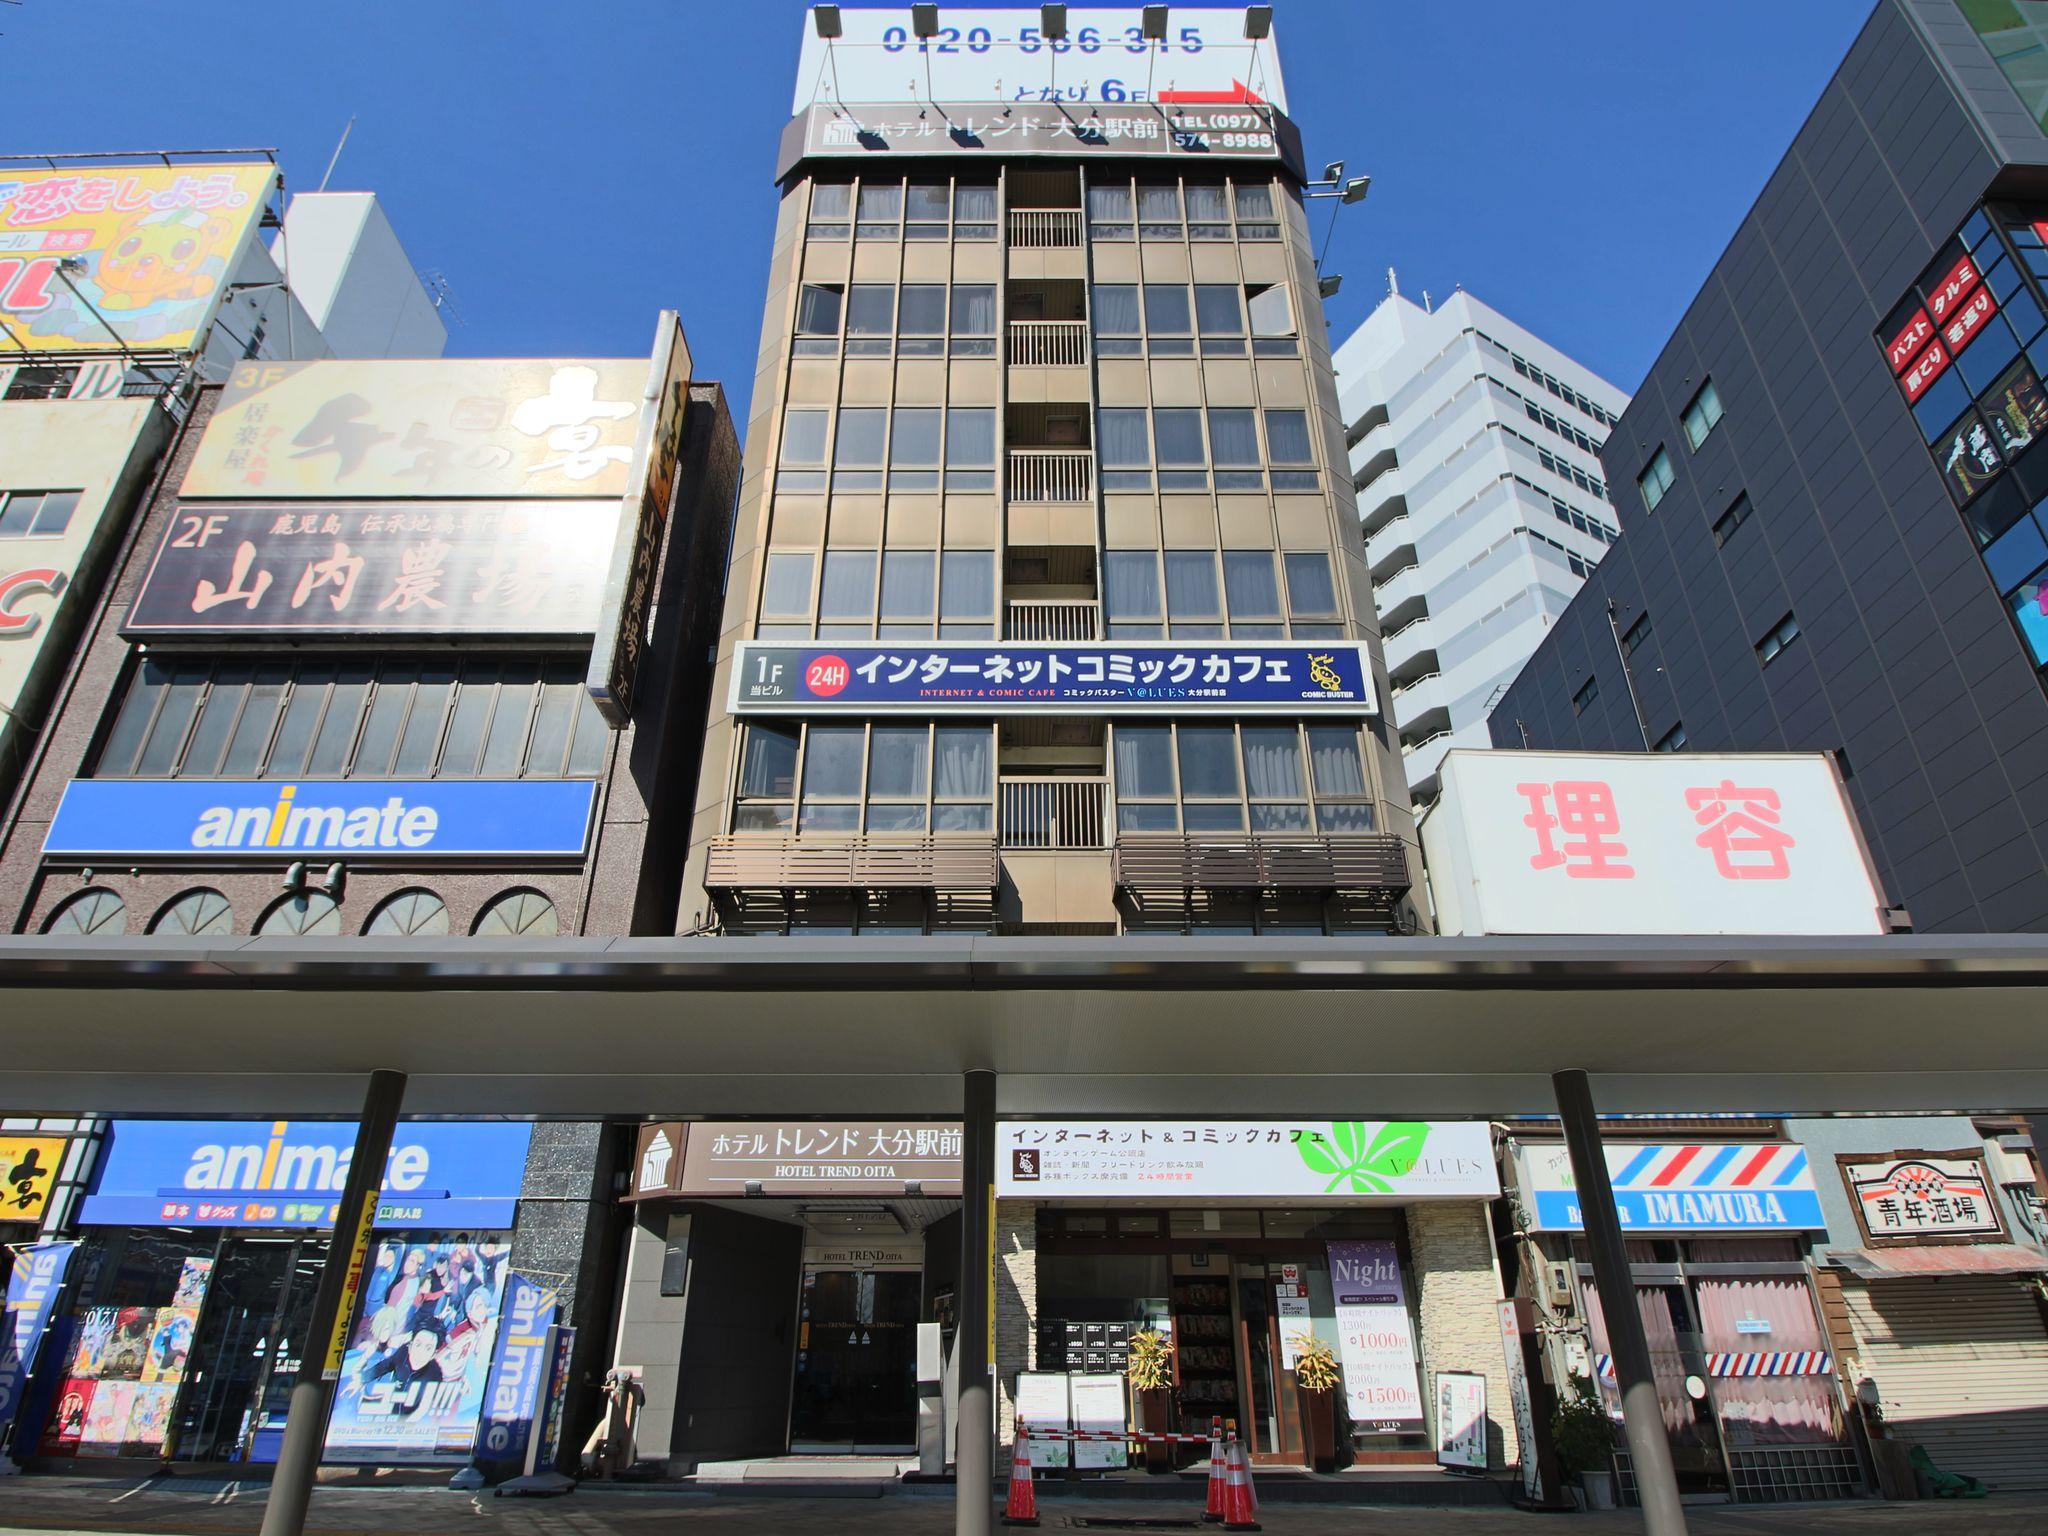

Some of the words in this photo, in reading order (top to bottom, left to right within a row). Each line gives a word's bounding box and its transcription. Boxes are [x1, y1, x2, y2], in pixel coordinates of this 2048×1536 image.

[1174, 133, 1272, 148] 574-8988
[1933, 265, 1973, 315] タルミ
[1893, 320, 1928, 364] バスト
[235, 367, 286, 389] 3F
[172, 515, 229, 548] 2F
[269, 513, 342, 535] 鹿児島
[756, 656, 783, 683] 1F
[810, 666, 845, 686] 24H
[856, 654, 1292, 684] インターネットコミックカフェ
[750, 685, 783, 697] 当ビル
[920, 688, 973, 697] INTERNET
[977, 689, 985, 697] &
[989, 689, 1024, 697] COMIC
[1028, 689, 1056, 697] CAFE
[1063, 689, 1125, 697] コミックバスター
[191, 785, 438, 848] animate
[1515, 779, 1796, 880] 理容
[183, 1121, 429, 1191] animae
[774, 1165, 816, 1178] HOTEL
[819, 1165, 860, 1178] TREND
[863, 1165, 897, 1178] OITA
[1642, 1193, 1788, 1224] IMAMURA
[1876, 1196, 1978, 1227] 青年酒場
[848, 1250, 884, 1260] TREND
[1335, 1258, 1396, 1287] Night
[487, 1285, 545, 1449] animate
